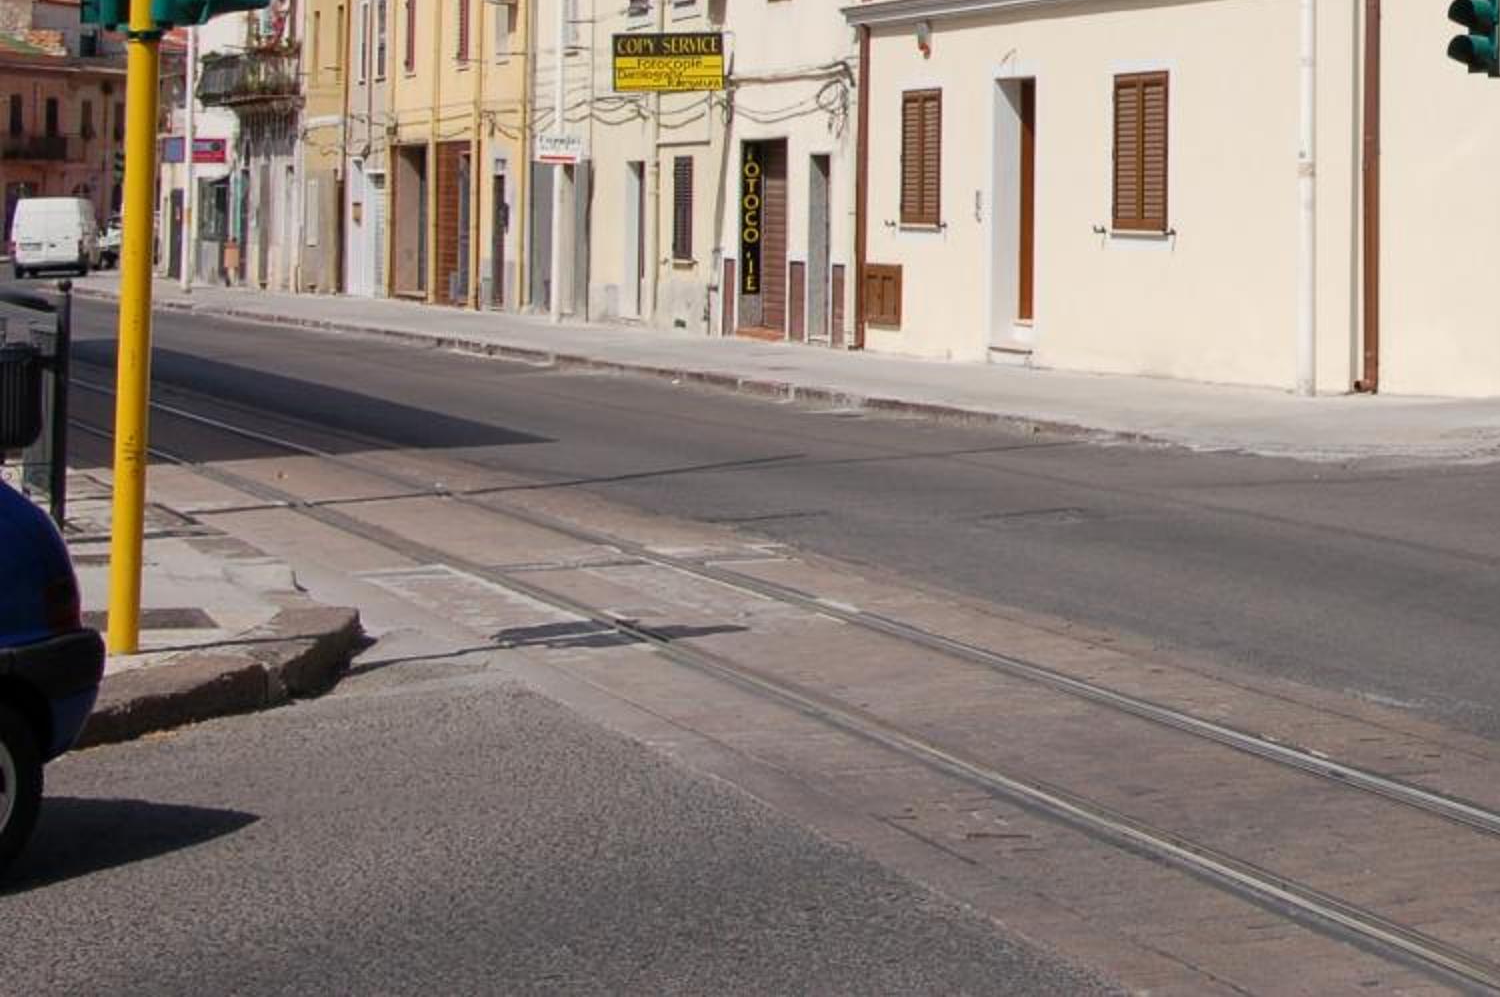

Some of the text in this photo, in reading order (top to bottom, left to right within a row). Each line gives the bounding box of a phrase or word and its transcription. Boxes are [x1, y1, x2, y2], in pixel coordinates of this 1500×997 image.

[616, 35, 719, 54] COPY SERVICE
[637, 57, 703, 72] Fotocopie
[743, 147, 761, 291] OTOCOIE
